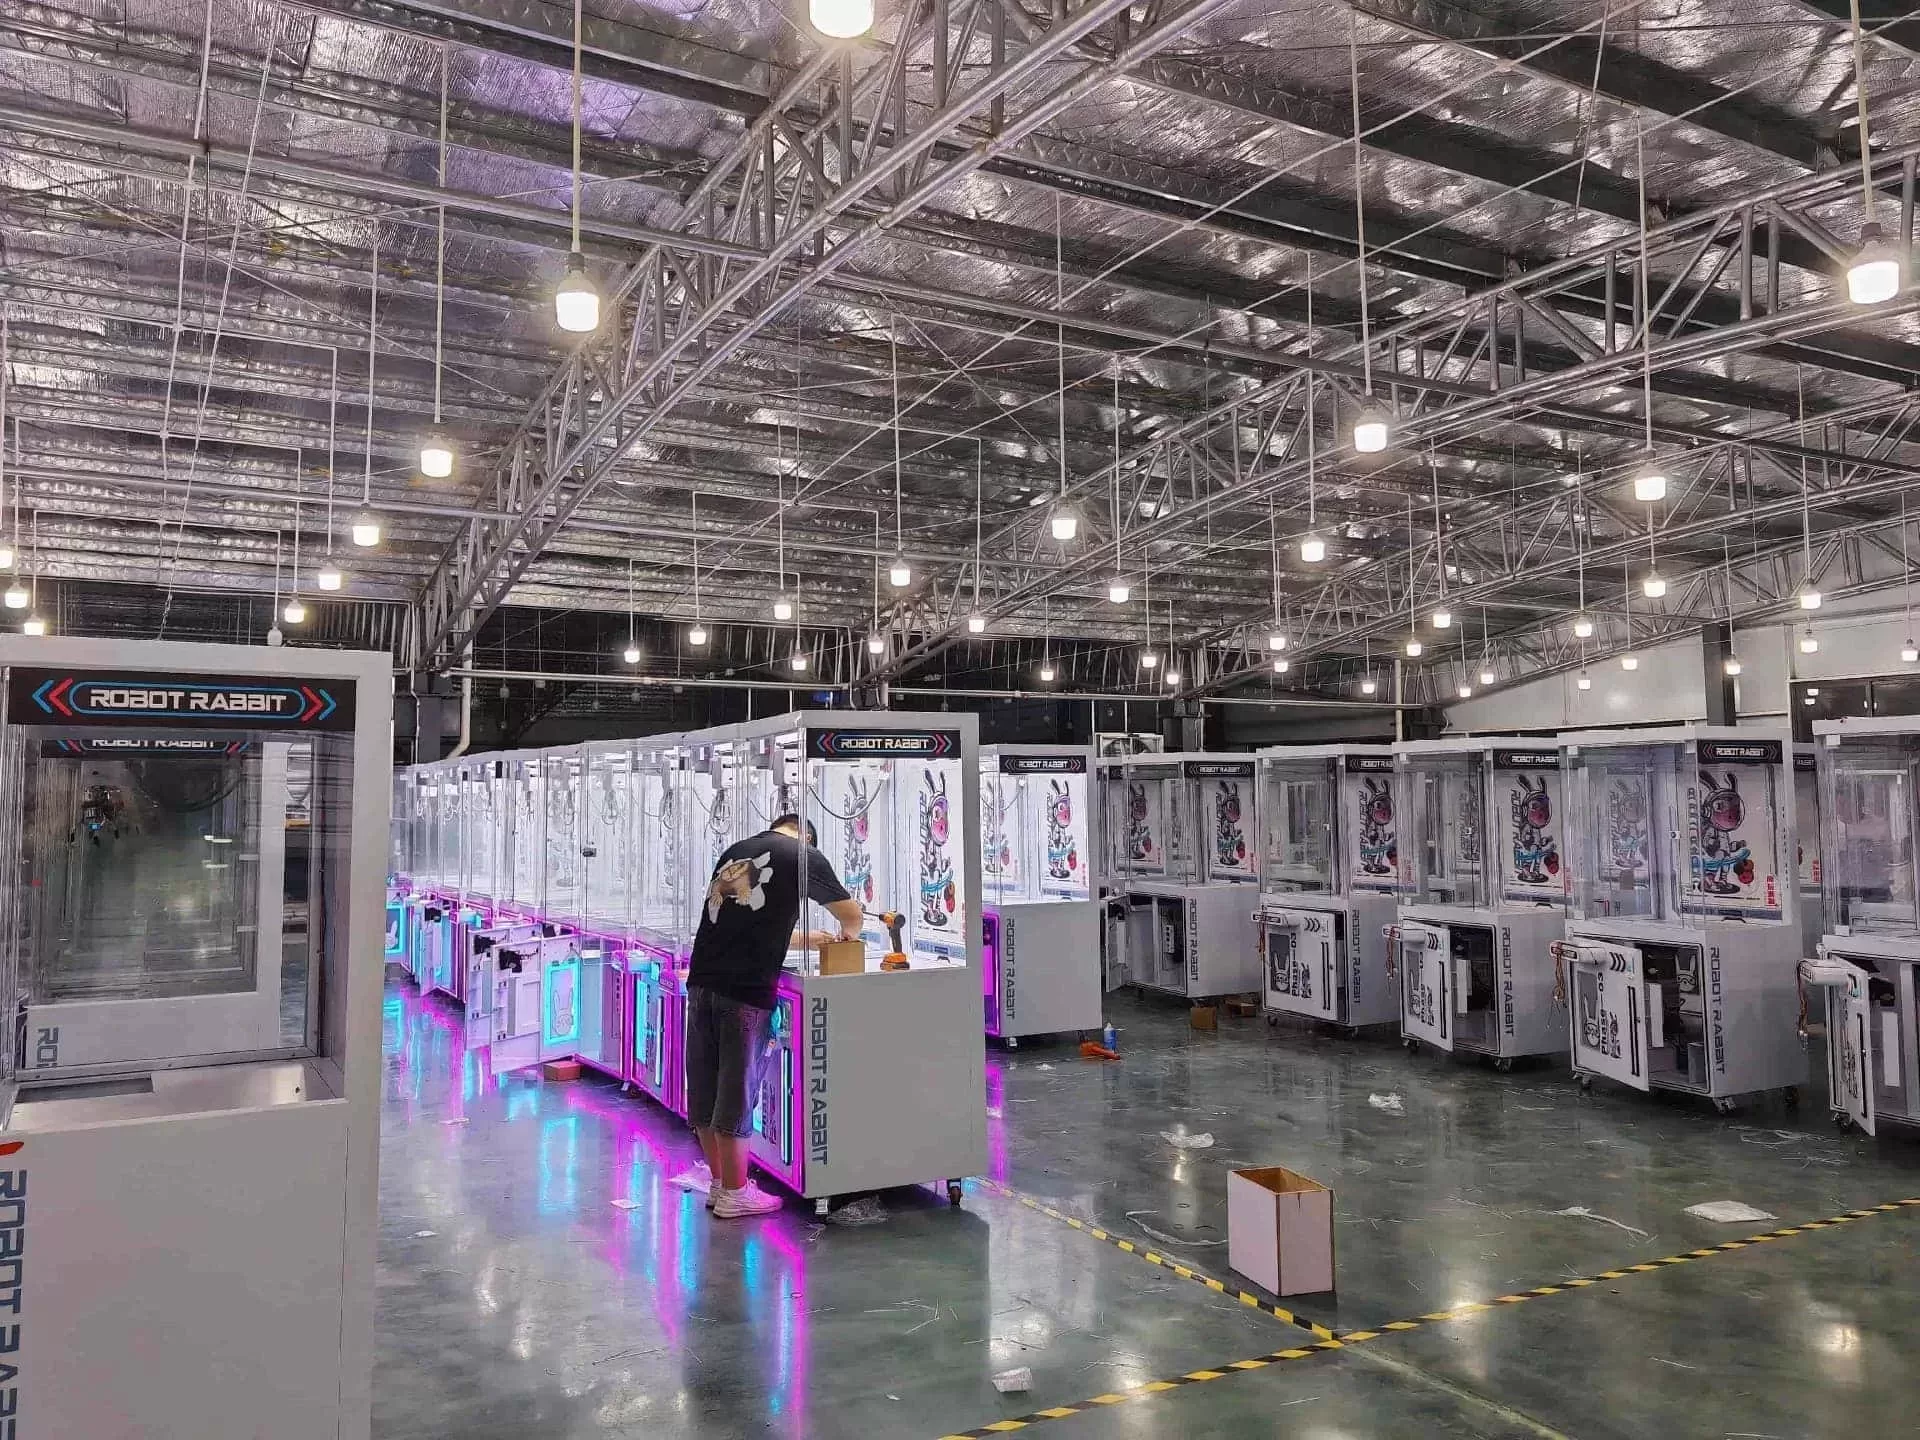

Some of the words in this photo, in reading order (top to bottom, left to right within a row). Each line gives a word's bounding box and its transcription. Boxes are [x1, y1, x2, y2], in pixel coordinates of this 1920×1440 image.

[90, 689, 185, 710] ROBOT
[189, 692, 287, 712] RABBIT
[841, 738, 882, 749] ROBOT
[885, 738, 929, 749] RABBIT
[1019, 760, 1041, 769] ROBOT
[1042, 760, 1068, 769] RABBIT
[1511, 755, 1534, 763] ROBOT
[1716, 748, 1739, 756] ROBOT
[1740, 748, 1765, 756] RABBIT
[1006, 918, 1015, 965] ROBOT
[1502, 927, 1513, 977] ROBOT
[1006, 968, 1016, 1021] RABBIT
[1710, 946, 1722, 1006] ROBOT
[1503, 980, 1514, 1038] RABBIT
[811, 997, 828, 1074] ROBOT
[1711, 1009, 1725, 1075] RABBIT
[811, 1078, 828, 1165] RABBIT
